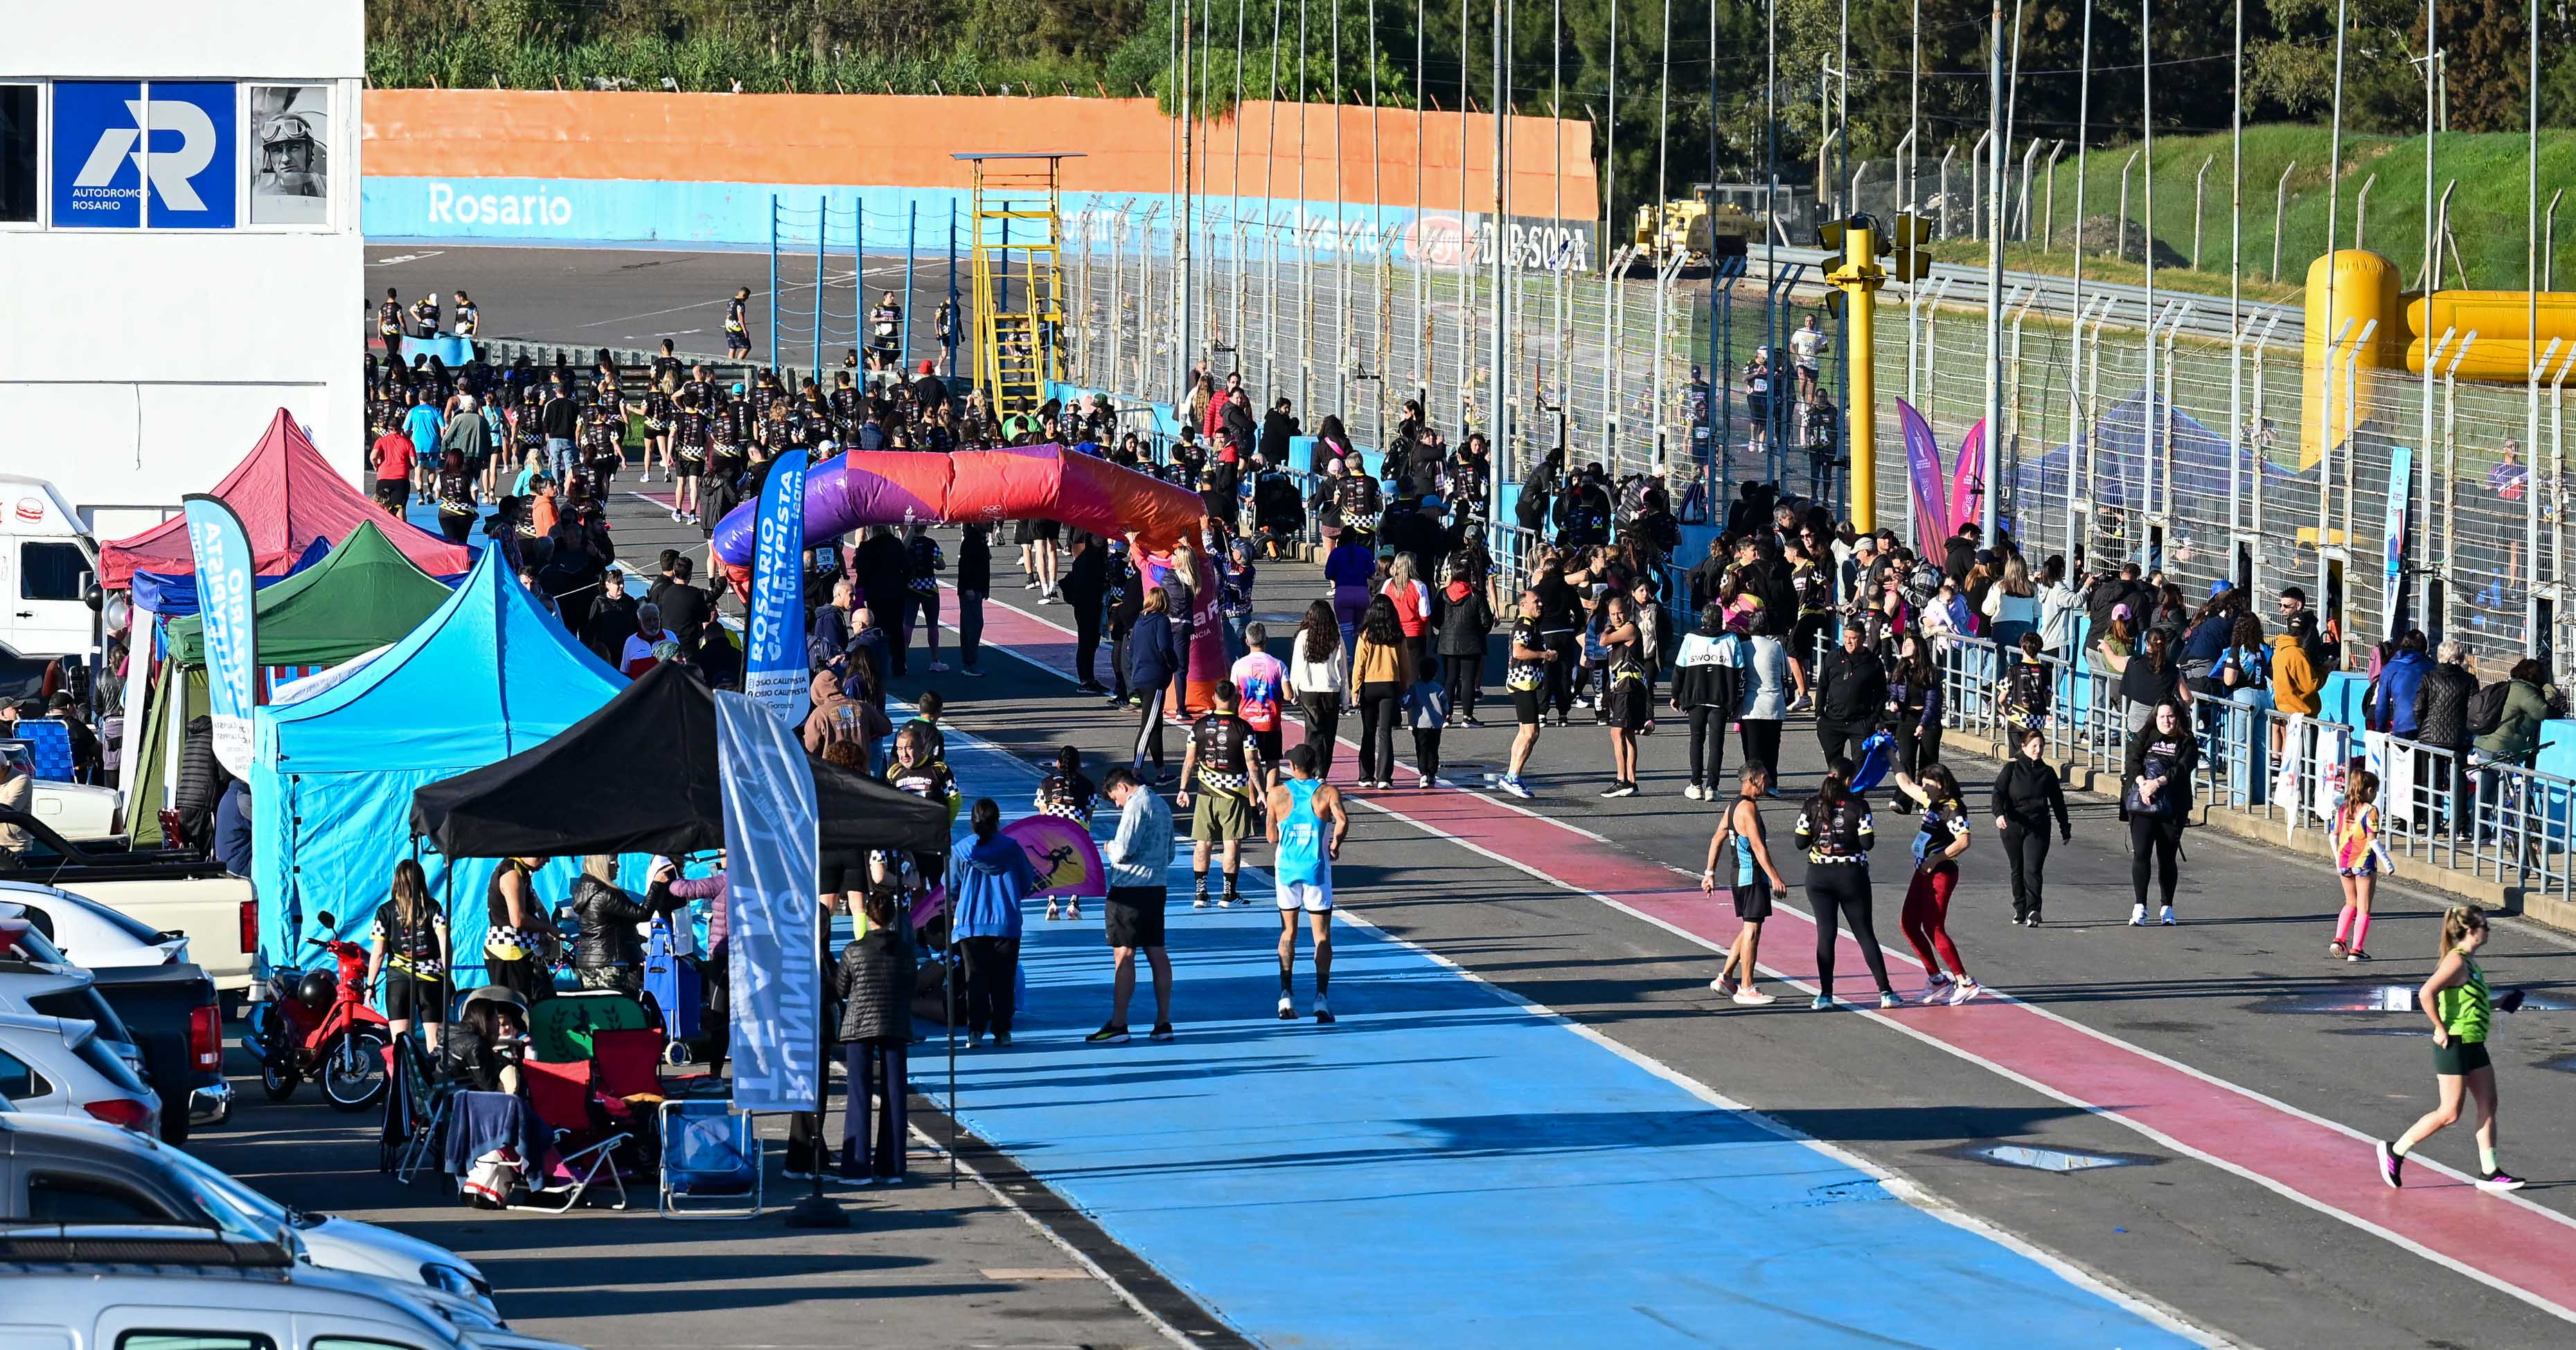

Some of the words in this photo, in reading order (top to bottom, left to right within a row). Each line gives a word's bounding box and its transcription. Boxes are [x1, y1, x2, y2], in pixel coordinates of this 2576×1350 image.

[73, 201, 121, 211] ROSARIO
[428, 182, 572, 226] Rosario
[751, 517, 774, 662] ROSARIO
[1190, 628, 1211, 641] INCIA
